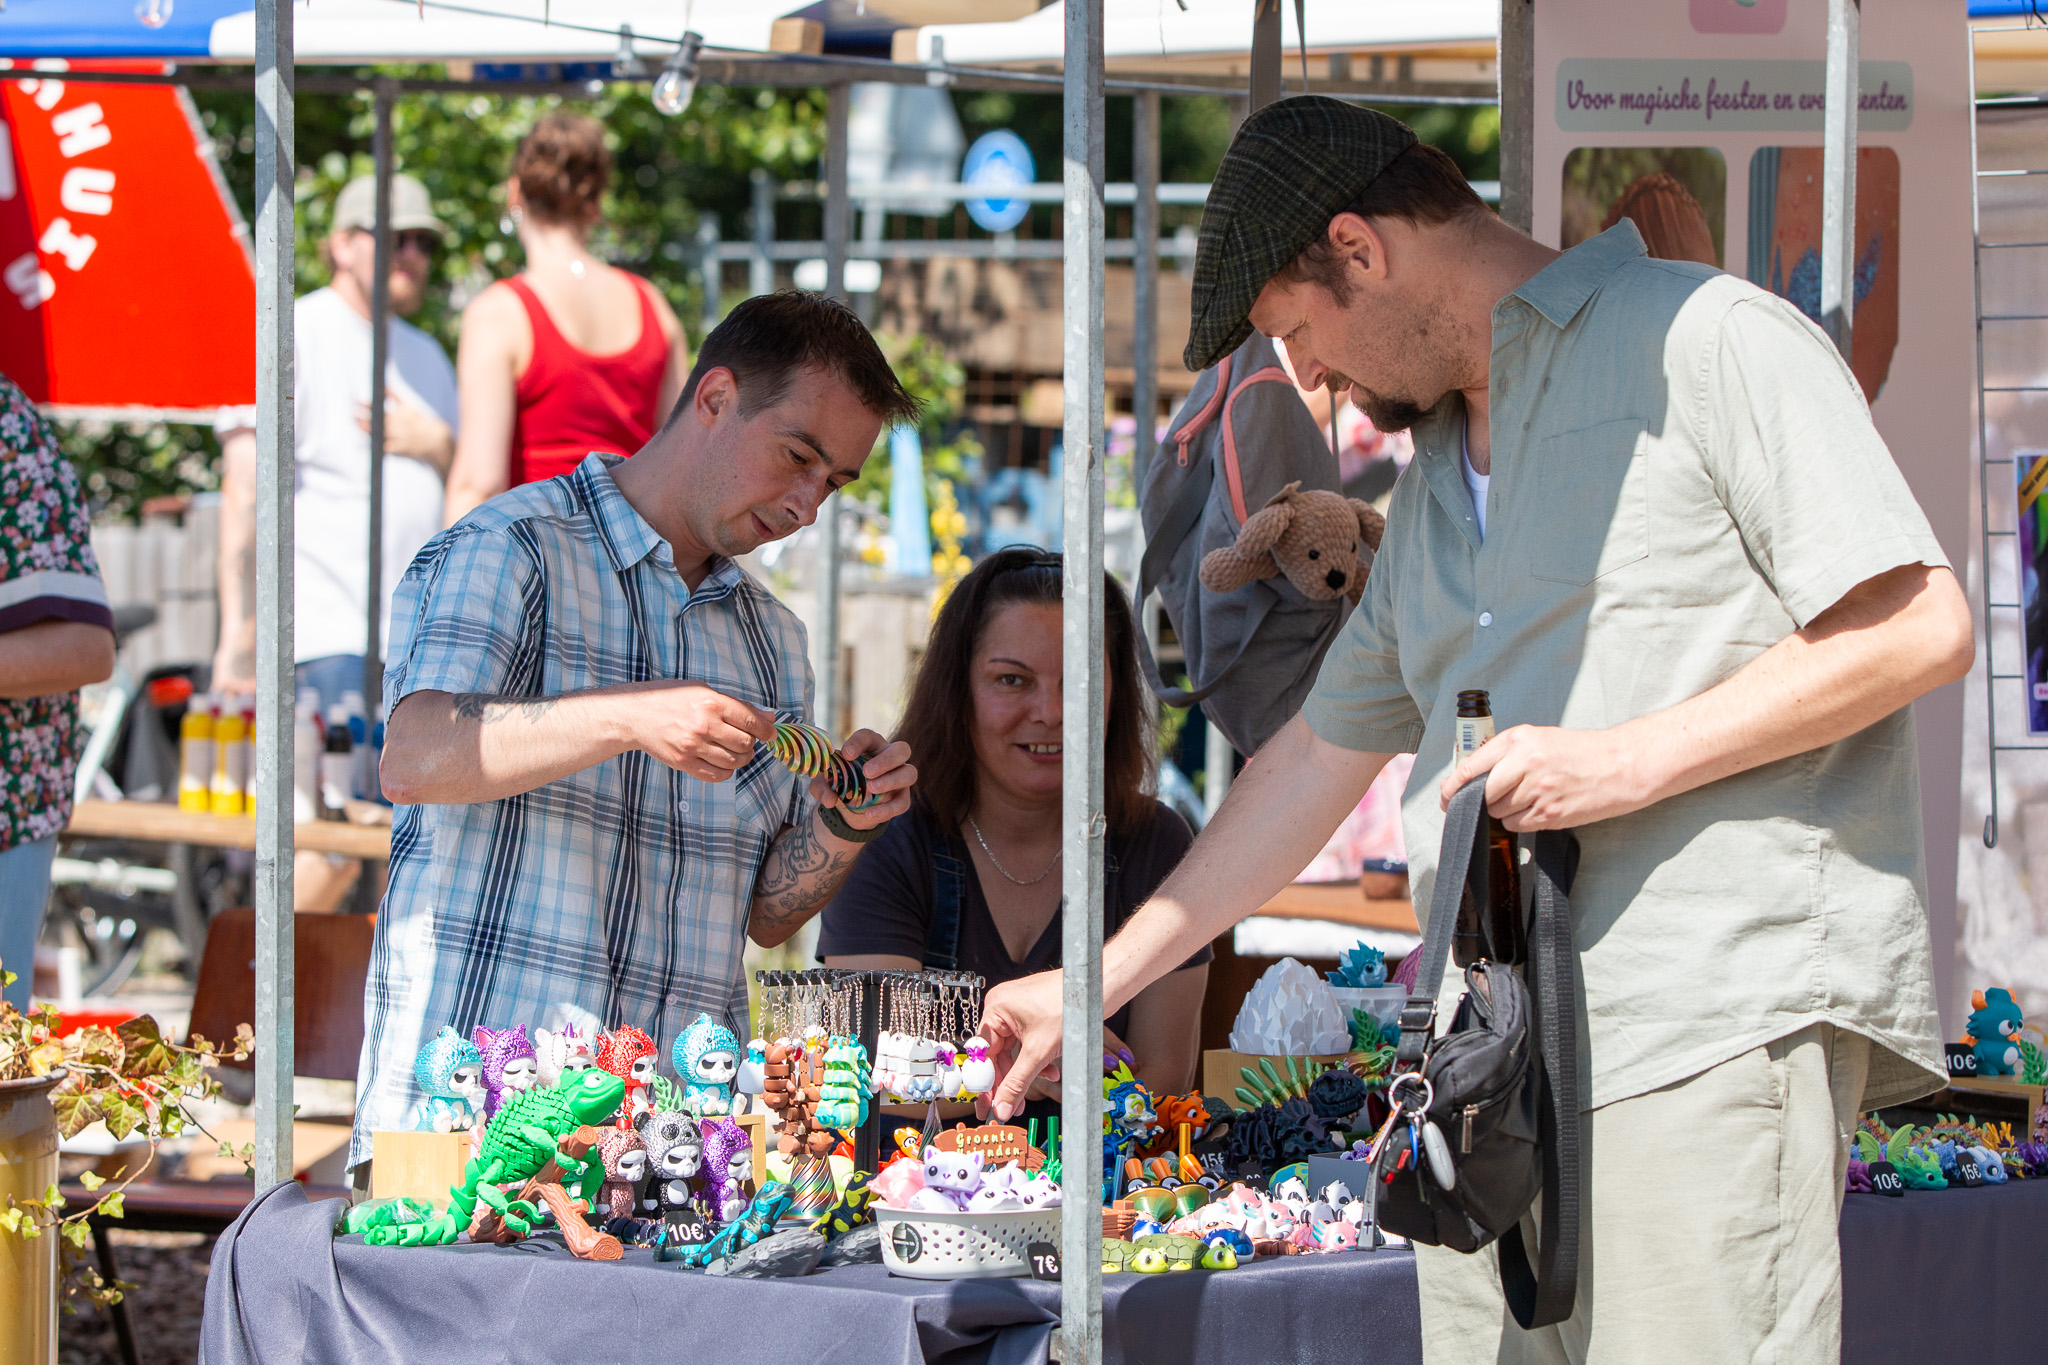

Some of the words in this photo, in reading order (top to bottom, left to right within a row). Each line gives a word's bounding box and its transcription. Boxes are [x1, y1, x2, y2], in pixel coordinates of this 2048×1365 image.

[1567, 79, 1615, 110] Voor
[1619, 77, 1702, 126] magische
[1706, 77, 1770, 120] feesten
[1773, 93, 1795, 111] en
[1946, 1053, 1977, 1070] 10€
[956, 1129, 1014, 1149] Groente
[1873, 1172, 1902, 1190] 10€
[1961, 1163, 1982, 1180] 15€
[669, 1222, 704, 1242] 10€
[1033, 1254, 1059, 1274] 7€
